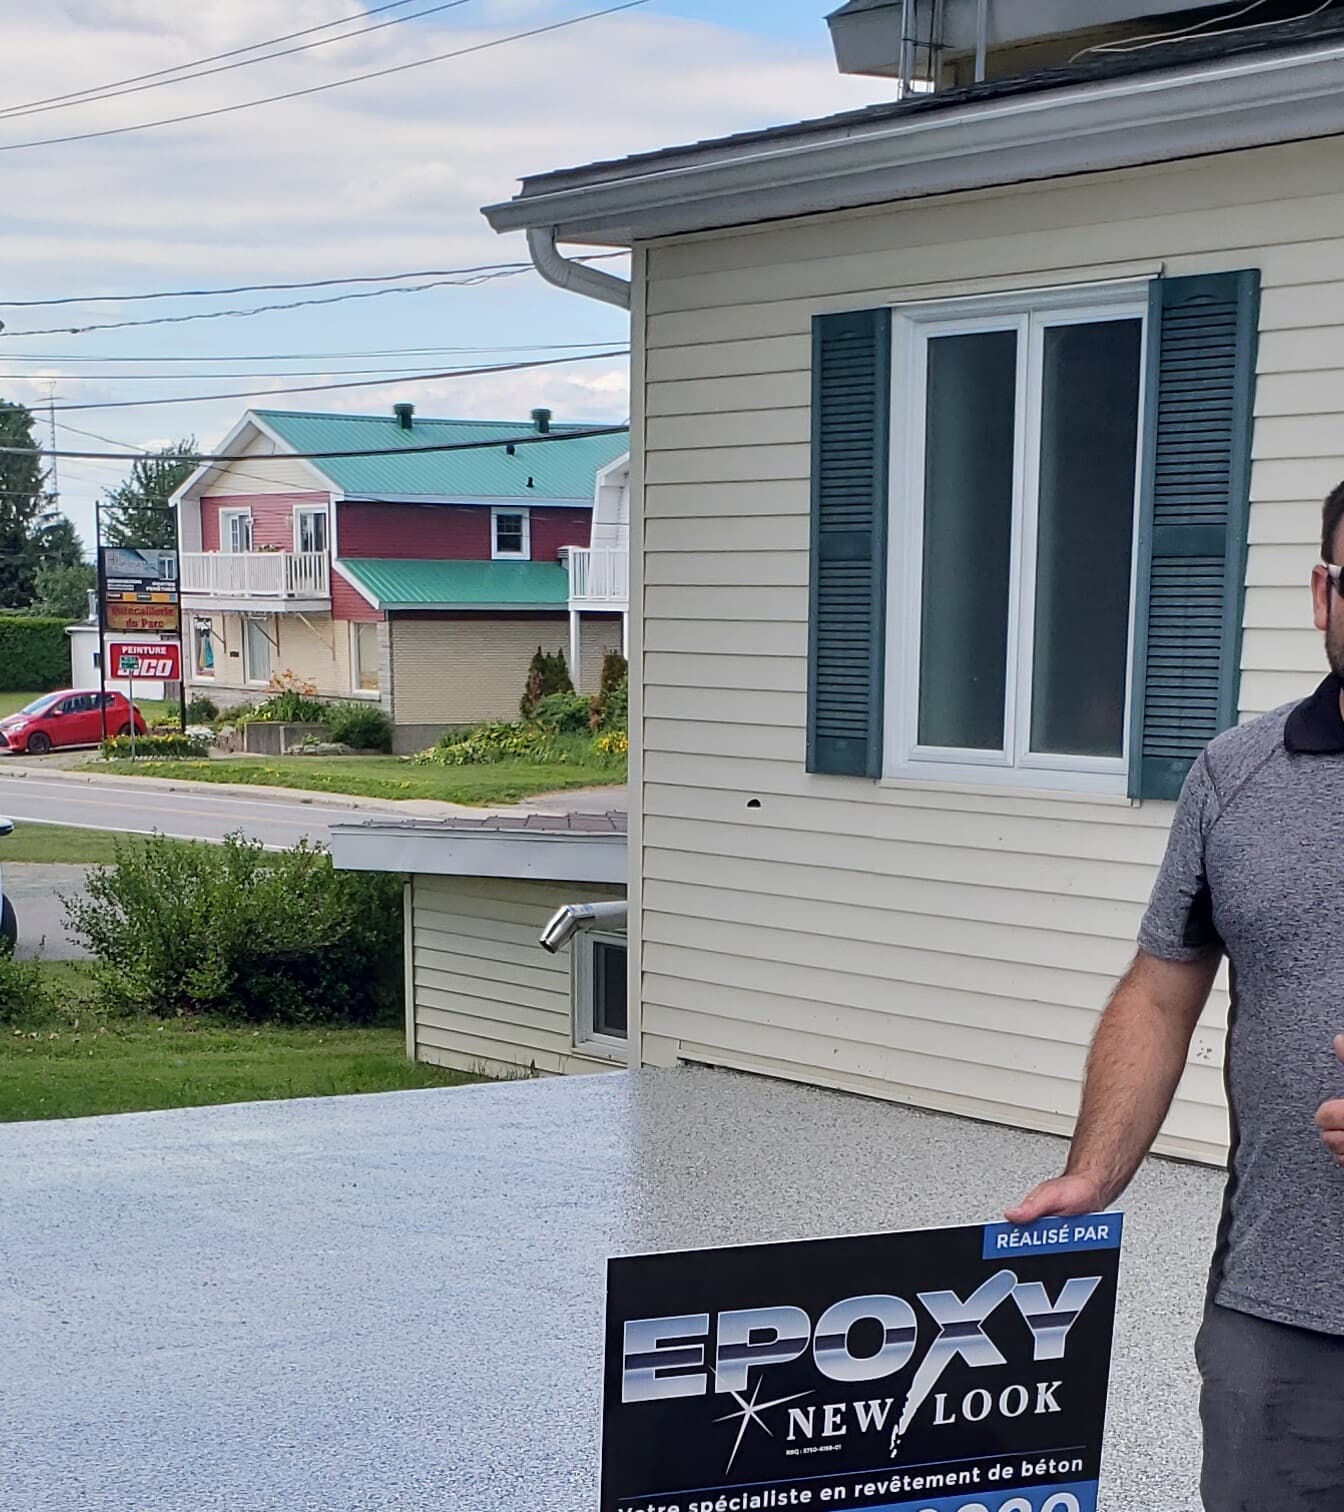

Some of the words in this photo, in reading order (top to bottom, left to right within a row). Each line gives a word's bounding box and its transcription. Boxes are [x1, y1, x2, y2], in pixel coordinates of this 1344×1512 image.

[121, 646, 166, 655] PEINTURE
[995, 1225, 1071, 1250] RÉALISÉ
[1072, 1224, 1110, 1242] PAR
[621, 1269, 1103, 1434] EPOXY
[785, 1397, 895, 1442] NEW
[932, 1381, 1064, 1427] LOOK
[819, 1482, 847, 1501] en
[853, 1465, 982, 1499] revêtement
[987, 1460, 1015, 1482] de
[1021, 1455, 1084, 1480] béton
